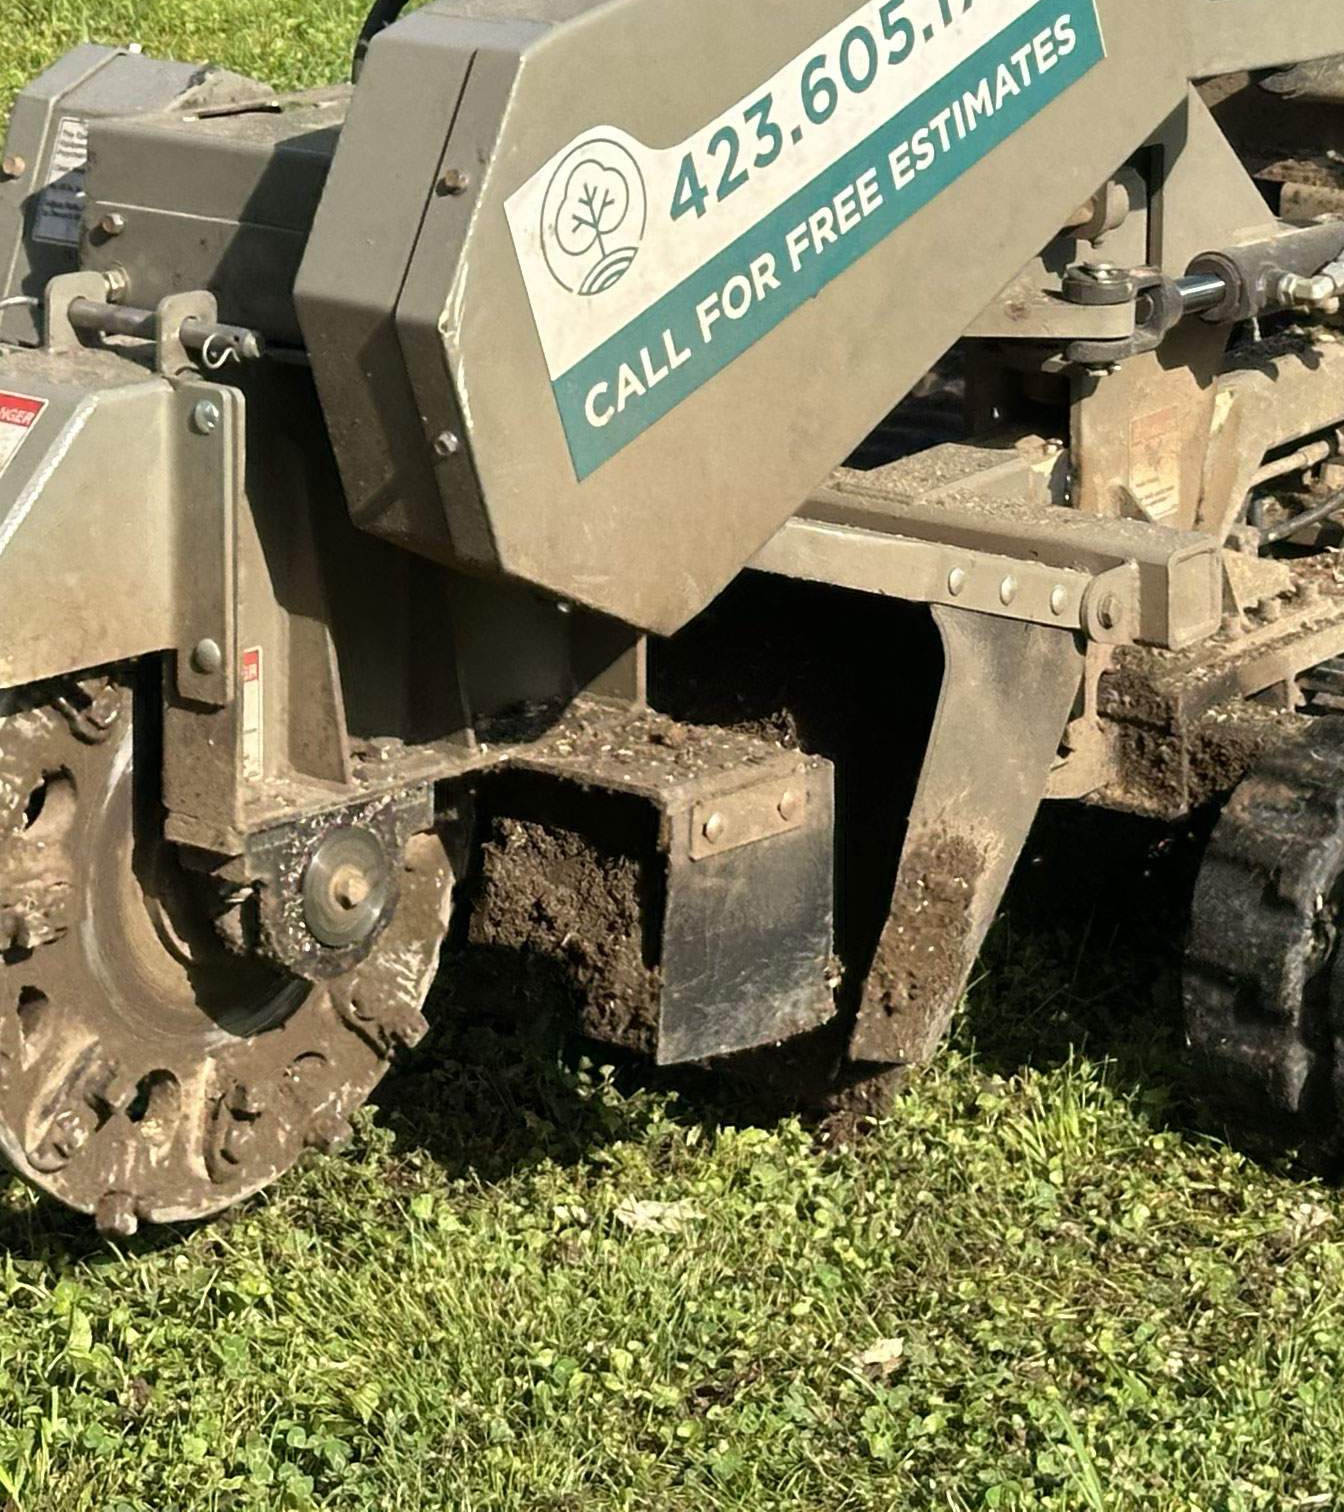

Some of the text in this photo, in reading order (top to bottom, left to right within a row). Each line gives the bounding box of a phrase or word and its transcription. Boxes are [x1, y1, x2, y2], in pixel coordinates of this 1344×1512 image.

[584, 13, 1077, 427] CALL FOR FREE ESTIMATES
